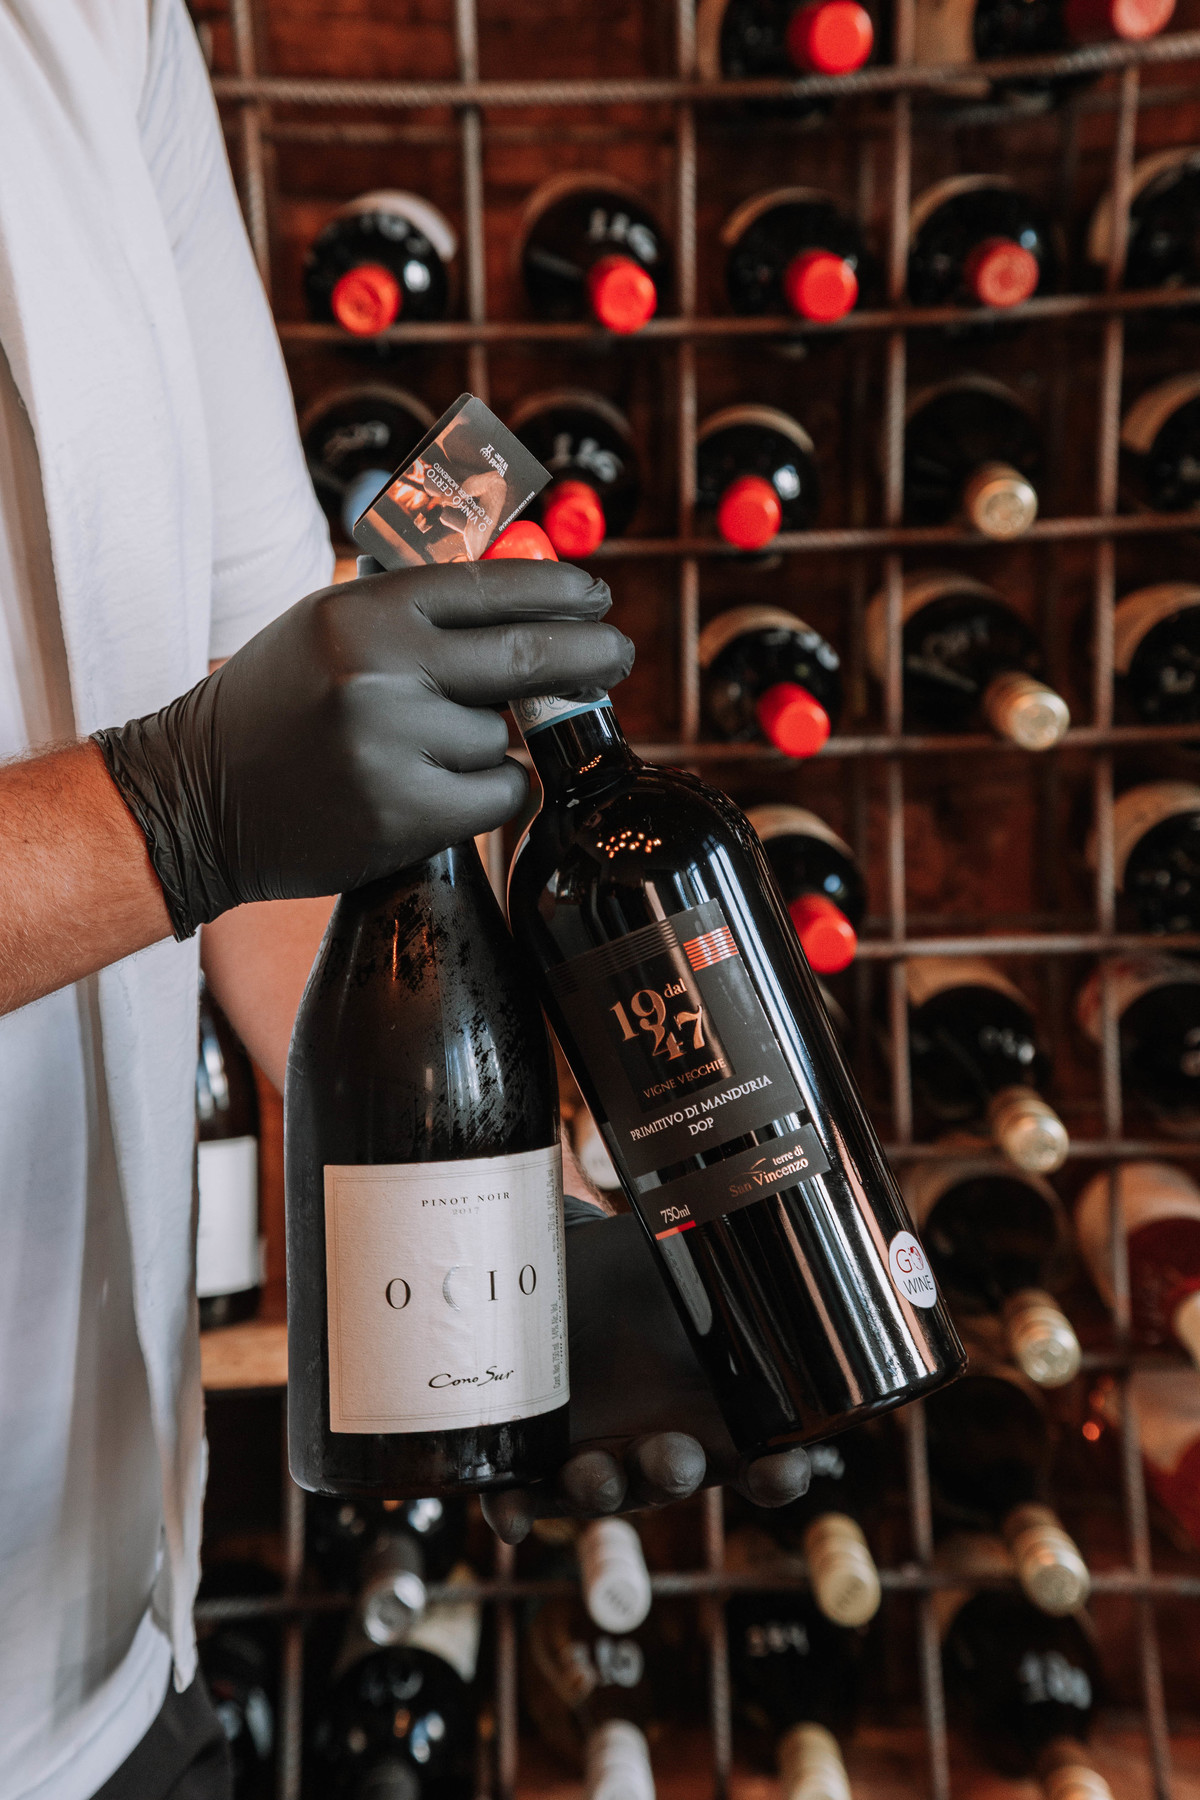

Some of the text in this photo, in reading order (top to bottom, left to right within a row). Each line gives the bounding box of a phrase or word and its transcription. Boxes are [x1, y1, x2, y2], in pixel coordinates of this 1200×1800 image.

[488, 457, 505, 478] World
[494, 452, 509, 471] Wine
[426, 468, 487, 532] O VINHO CERTO
[433, 462, 494, 527] EM QUALQUER MOMENTO
[663, 977, 688, 999] dal
[643, 1057, 728, 1099] VIGNE VECCHIE
[629, 1074, 773, 1142] PRIMITIVO DI MANDURIA
[687, 1116, 715, 1136] DOP
[772, 1144, 804, 1166] terre di
[729, 1157, 809, 1198] San Vincenzo
[421, 1191, 511, 1207] PINOT NOIR
[451, 1206, 480, 1216] 2017
[660, 1204, 691, 1224] 750ml
[903, 1275, 934, 1295] WINE
[428, 1365, 514, 1389] Cono Sur
